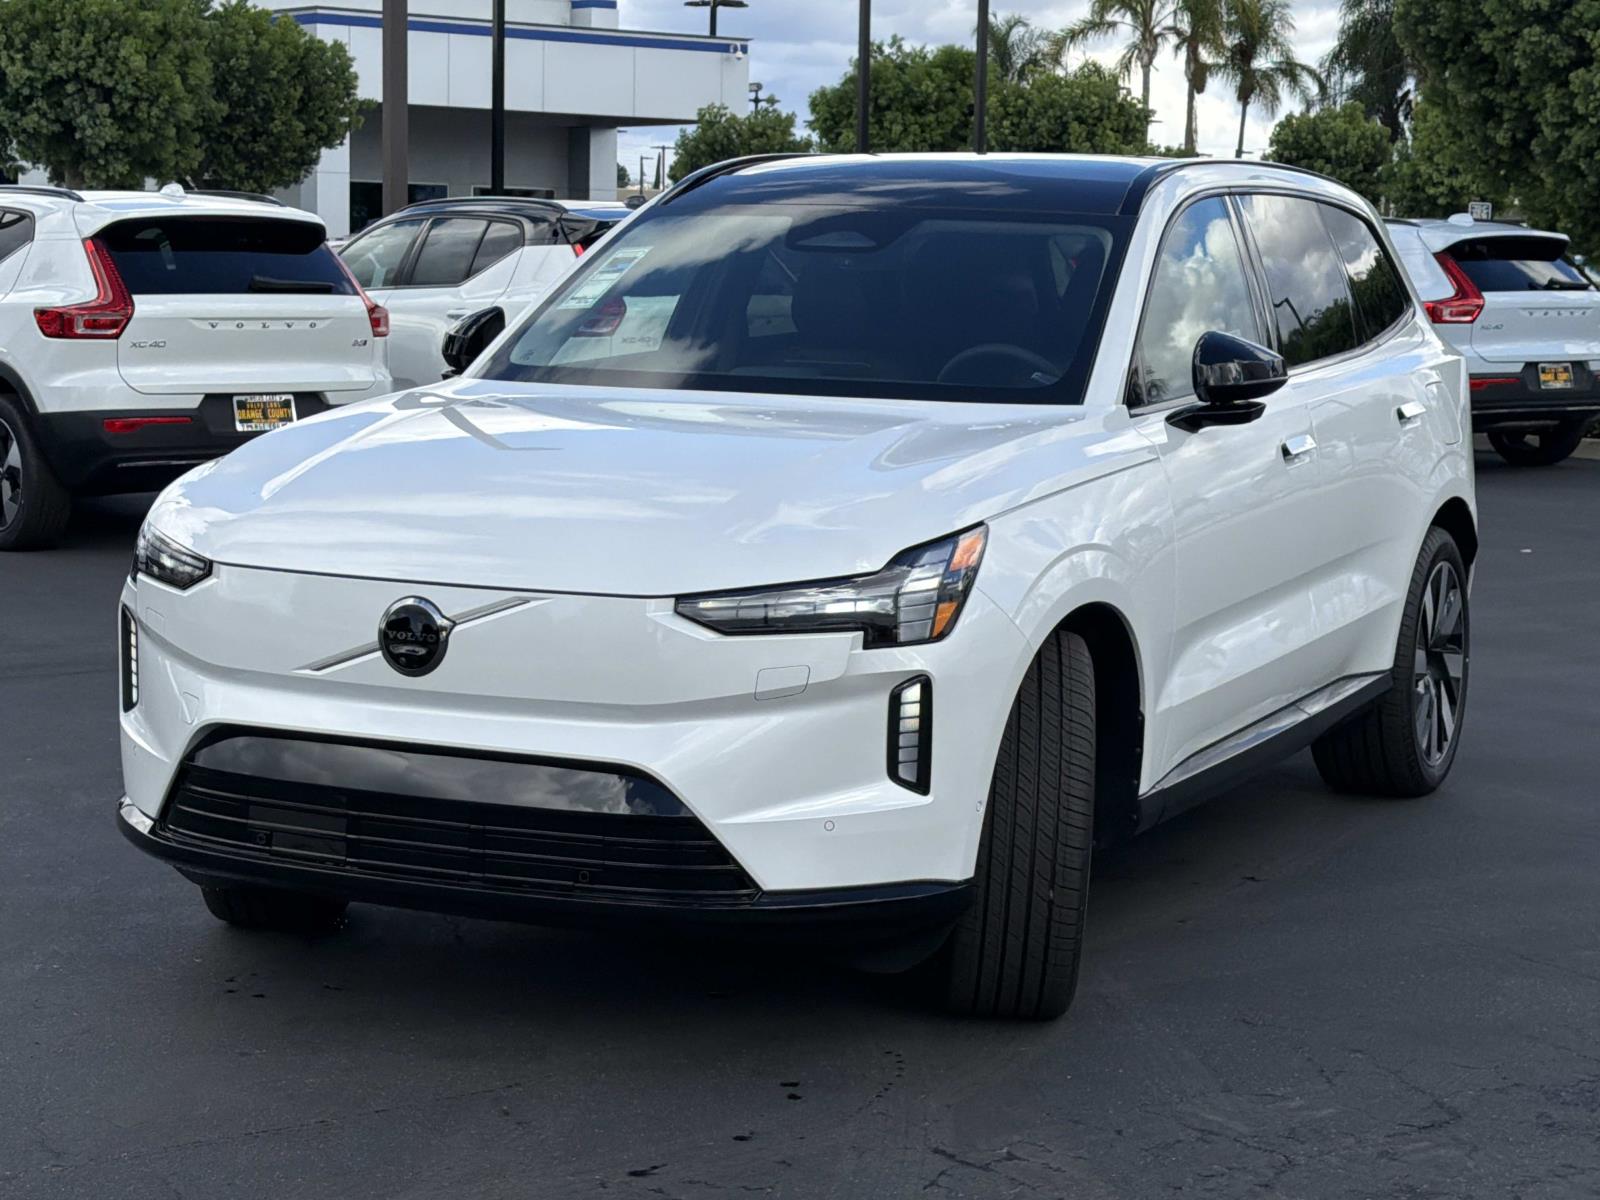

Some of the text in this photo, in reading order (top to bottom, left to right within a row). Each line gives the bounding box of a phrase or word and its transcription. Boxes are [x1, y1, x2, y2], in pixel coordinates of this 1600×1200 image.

[207, 321, 318, 329] VOLVO
[237, 407, 293, 420] ORANGE COUNTY
[386, 630, 437, 642] VOLVO
